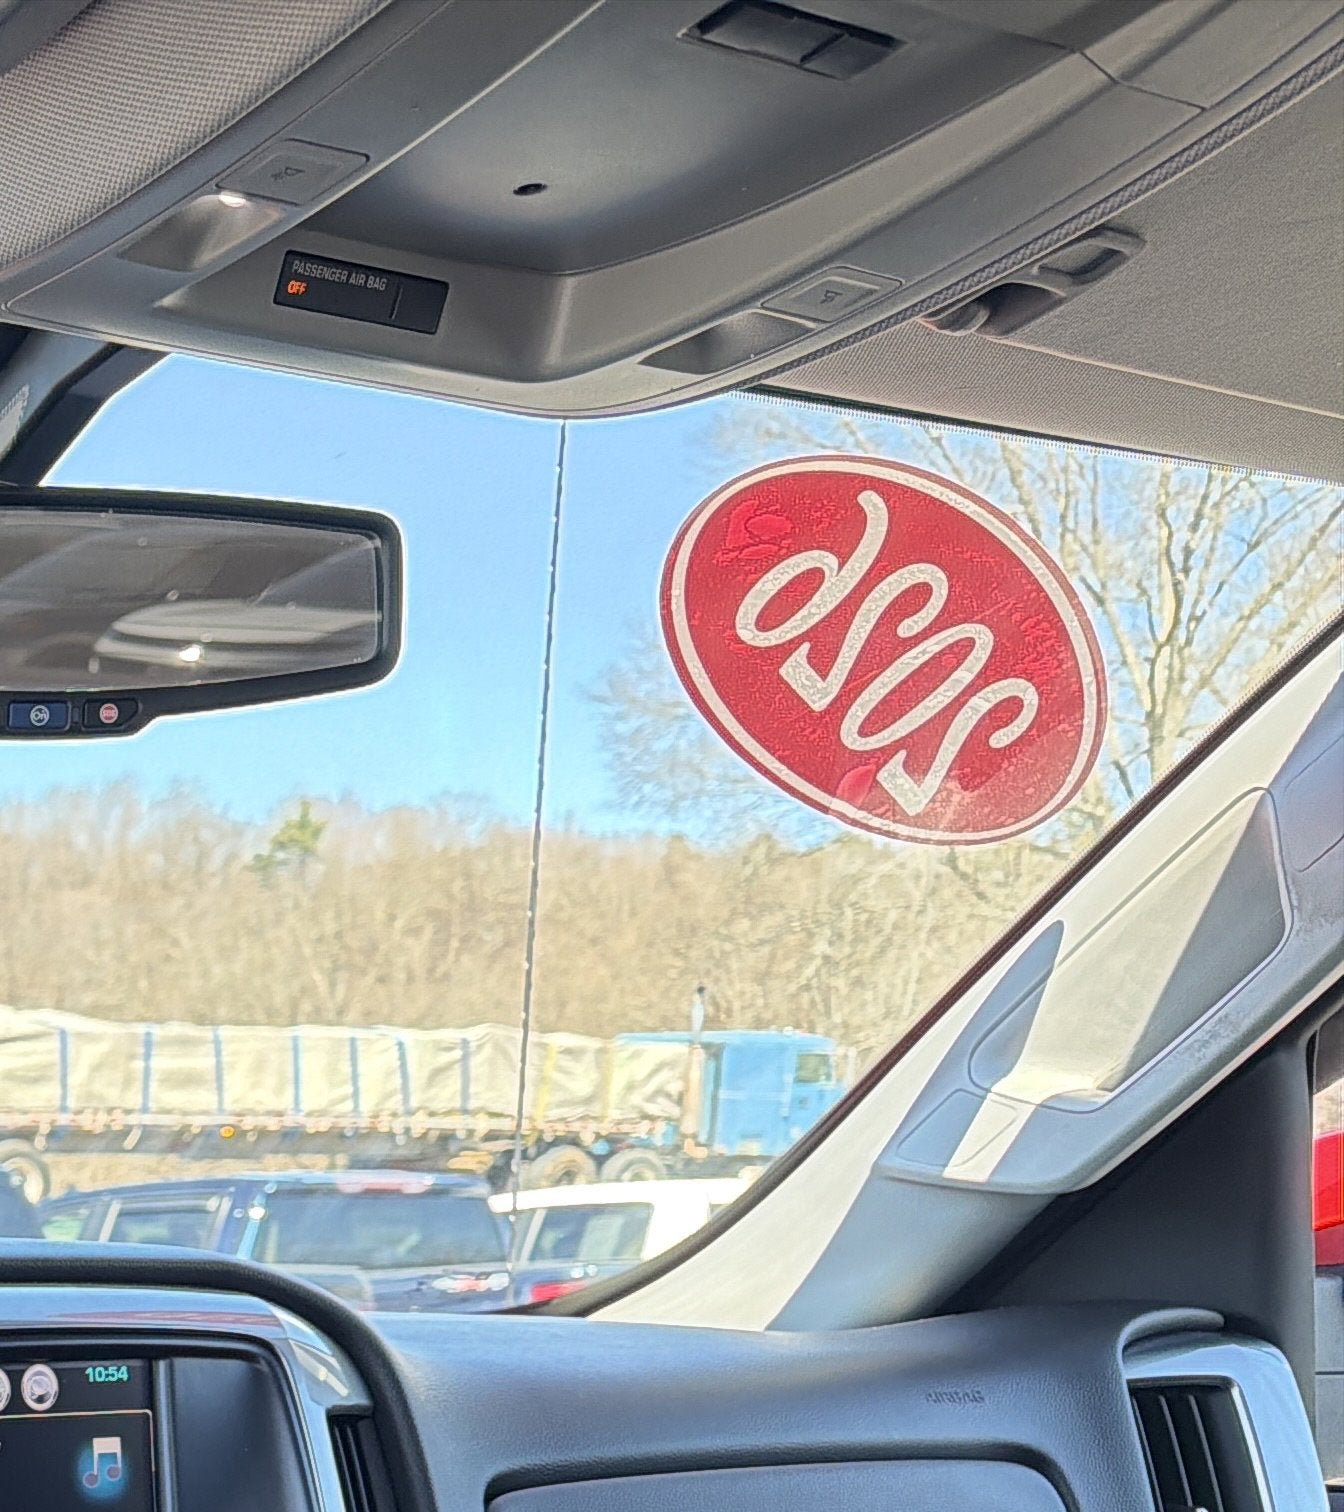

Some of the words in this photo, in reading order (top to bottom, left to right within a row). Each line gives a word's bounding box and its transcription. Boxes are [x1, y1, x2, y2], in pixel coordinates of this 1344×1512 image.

[291, 260, 347, 283] PASSENGER
[348, 272, 366, 287] AIR
[367, 276, 388, 291] BAG
[287, 280, 307, 295] OFF
[85, 1366, 129, 1383] 10:54
